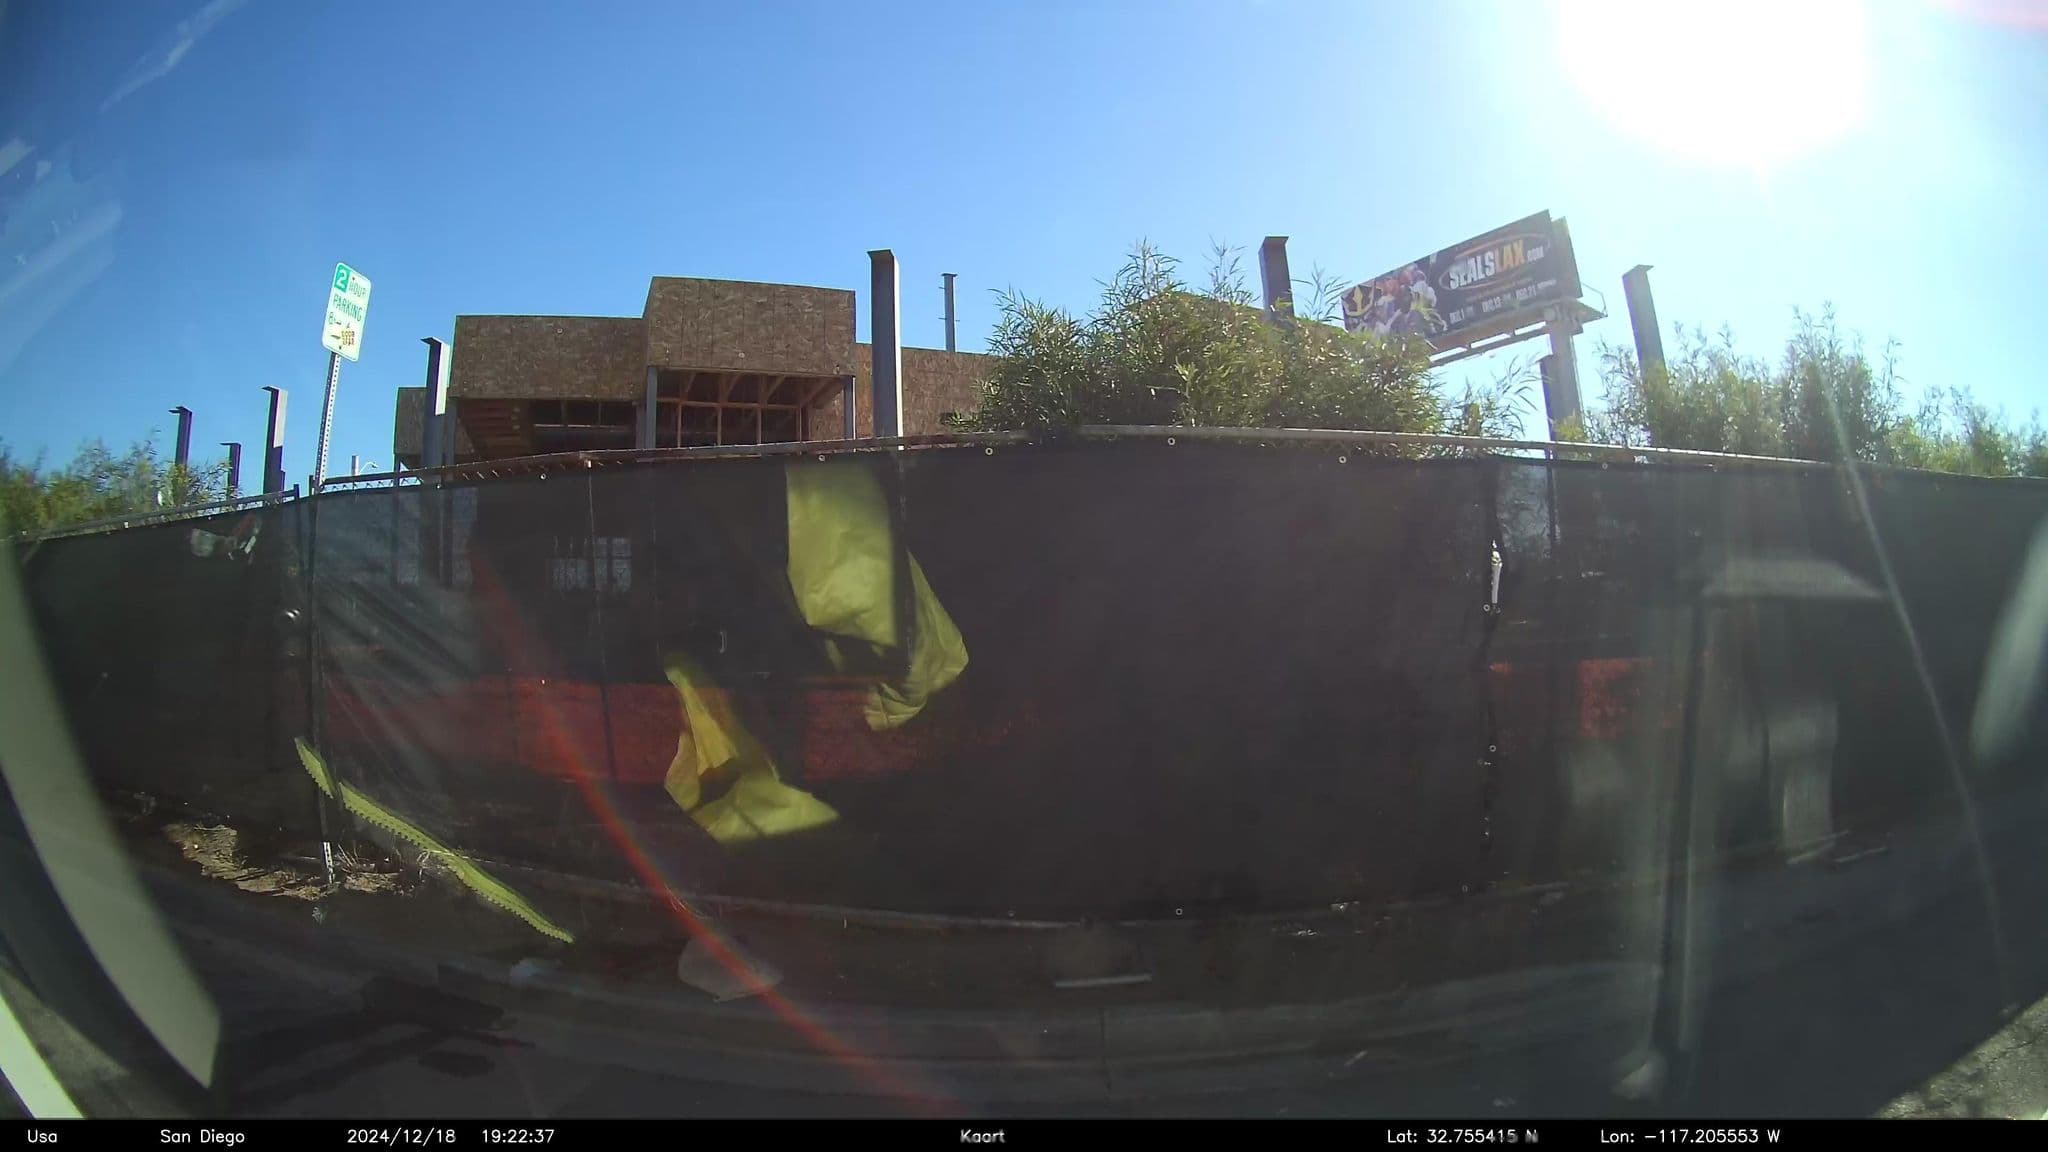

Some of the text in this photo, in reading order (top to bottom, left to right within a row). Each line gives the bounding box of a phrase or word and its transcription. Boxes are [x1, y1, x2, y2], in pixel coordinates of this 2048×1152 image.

[335, 268, 347, 289] 2
[1449, 239, 1525, 290] SEALSLAX
[333, 293, 362, 322] PARKING
